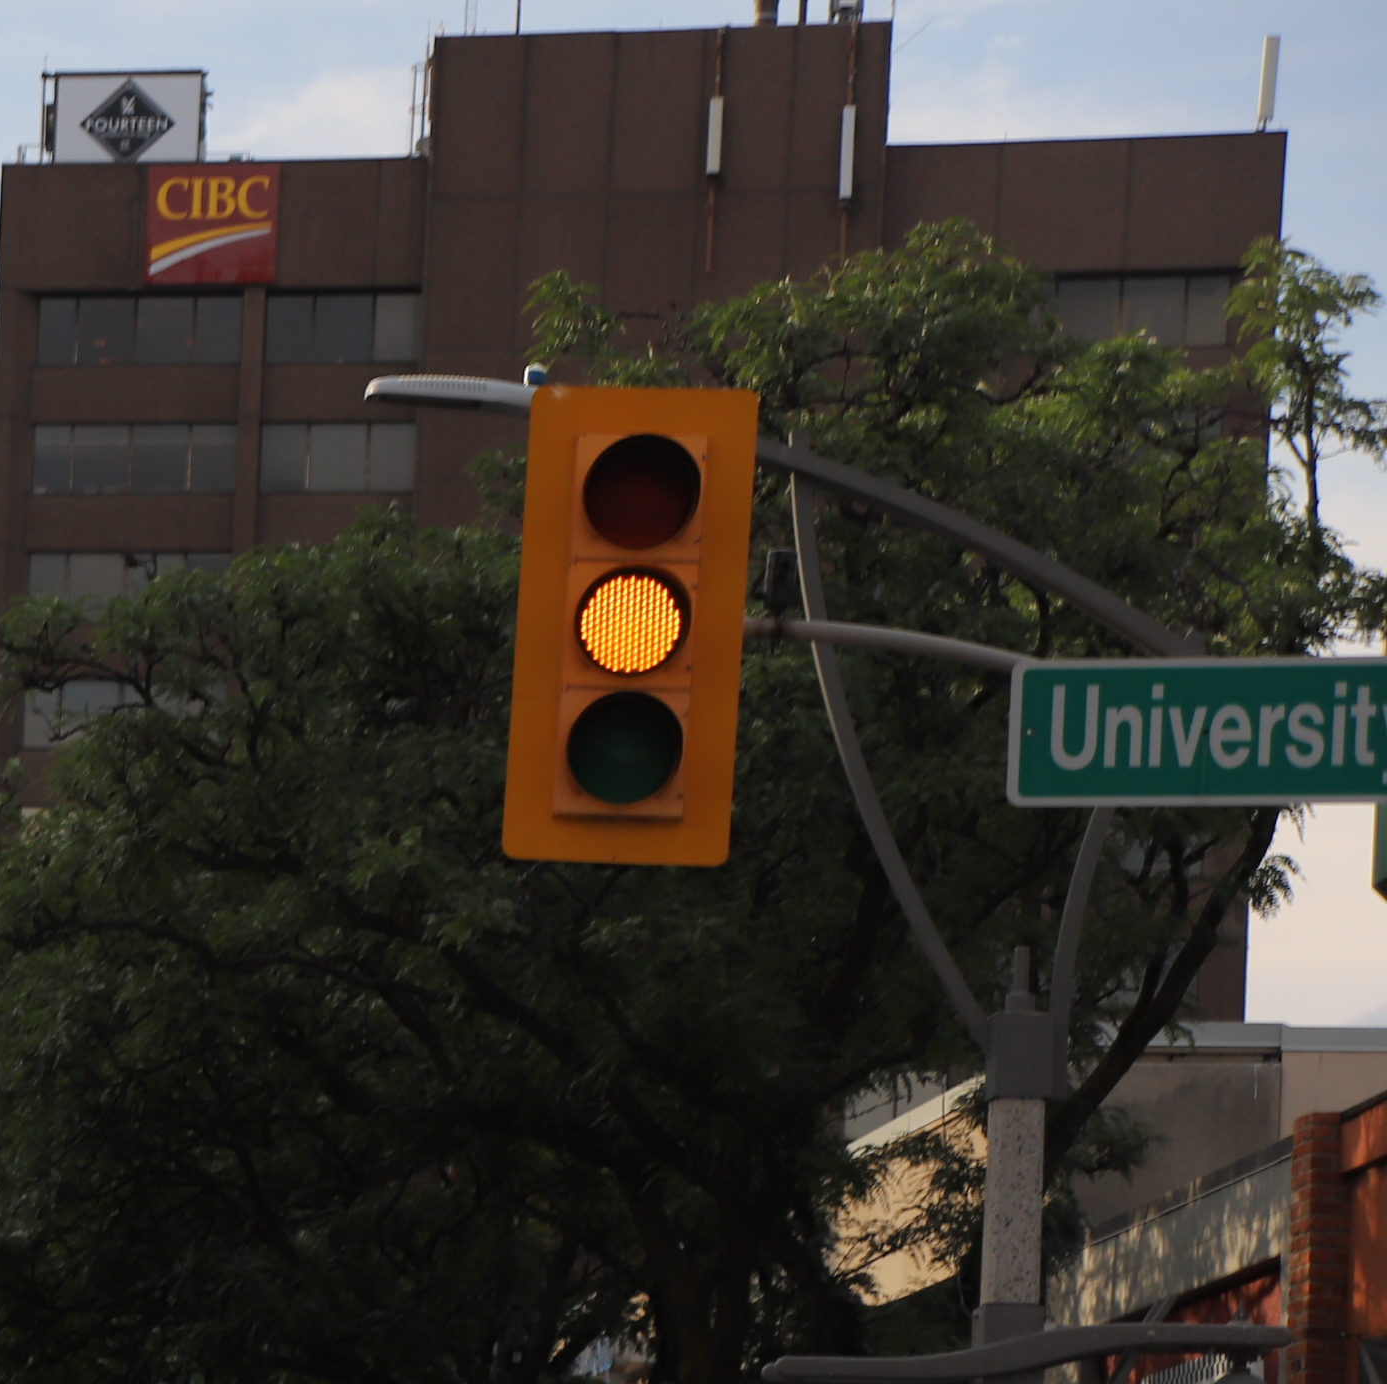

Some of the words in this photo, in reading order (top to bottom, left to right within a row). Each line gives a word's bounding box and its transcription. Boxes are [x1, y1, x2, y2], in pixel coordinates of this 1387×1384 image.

[86, 115, 169, 133] FOURTEEN
[157, 175, 271, 220] CIBC
[1049, 681, 1387, 785] Universit
